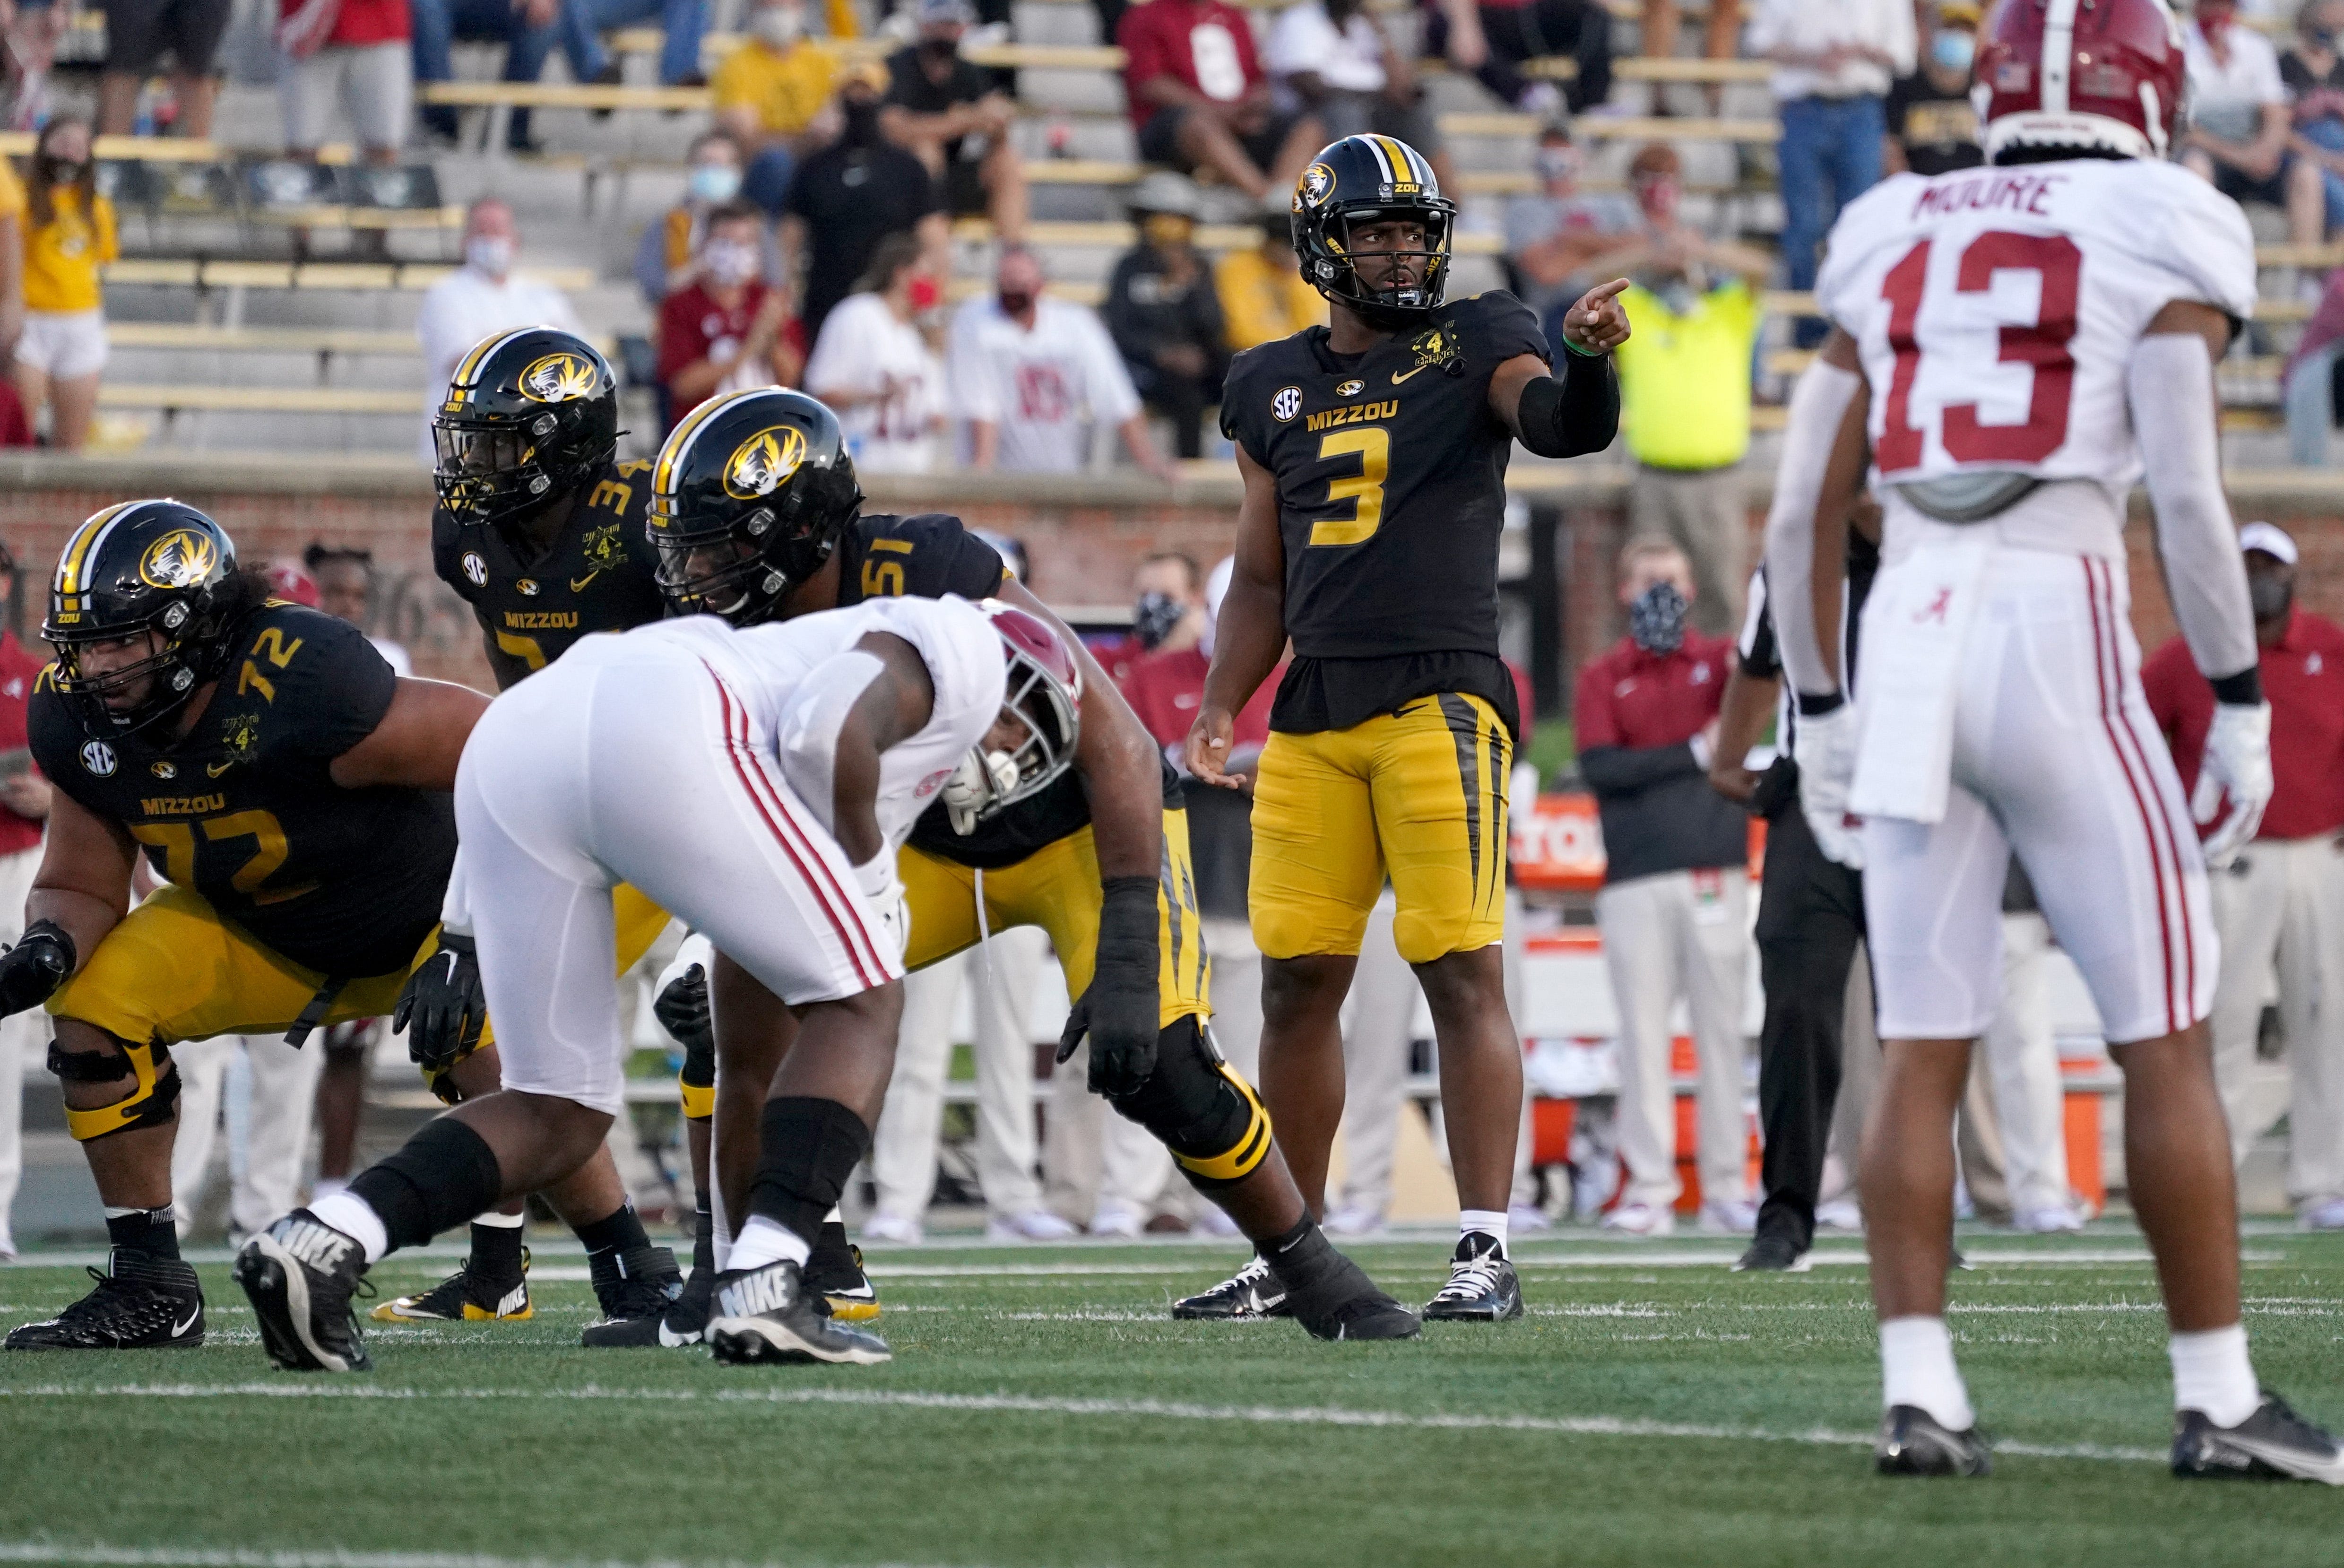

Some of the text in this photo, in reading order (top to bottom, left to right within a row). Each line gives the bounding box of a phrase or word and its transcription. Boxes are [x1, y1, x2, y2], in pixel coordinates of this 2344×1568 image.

[1395, 184, 1419, 193] ZOU
[1427, 332, 1443, 353] 4
[1875, 229, 2082, 474] 13
[445, 402, 463, 412] ZOU
[1273, 388, 1300, 420] SEC
[1306, 400, 1398, 432] MIZZOU
[588, 459, 654, 516] 34
[1309, 427, 1389, 545] 3
[464, 554, 485, 585] SEC
[861, 537, 914, 598] 51
[58, 613, 80, 624] ZOU
[503, 611, 578, 629] MIZZOU
[238, 628, 303, 704] 72
[83, 742, 114, 775] SEC
[141, 793, 225, 815] MIZZOU
[131, 810, 320, 906] 72
[272, 1219, 355, 1277] NIKE
[496, 1282, 526, 1319] NIKE
[719, 1268, 788, 1317] NIKE
